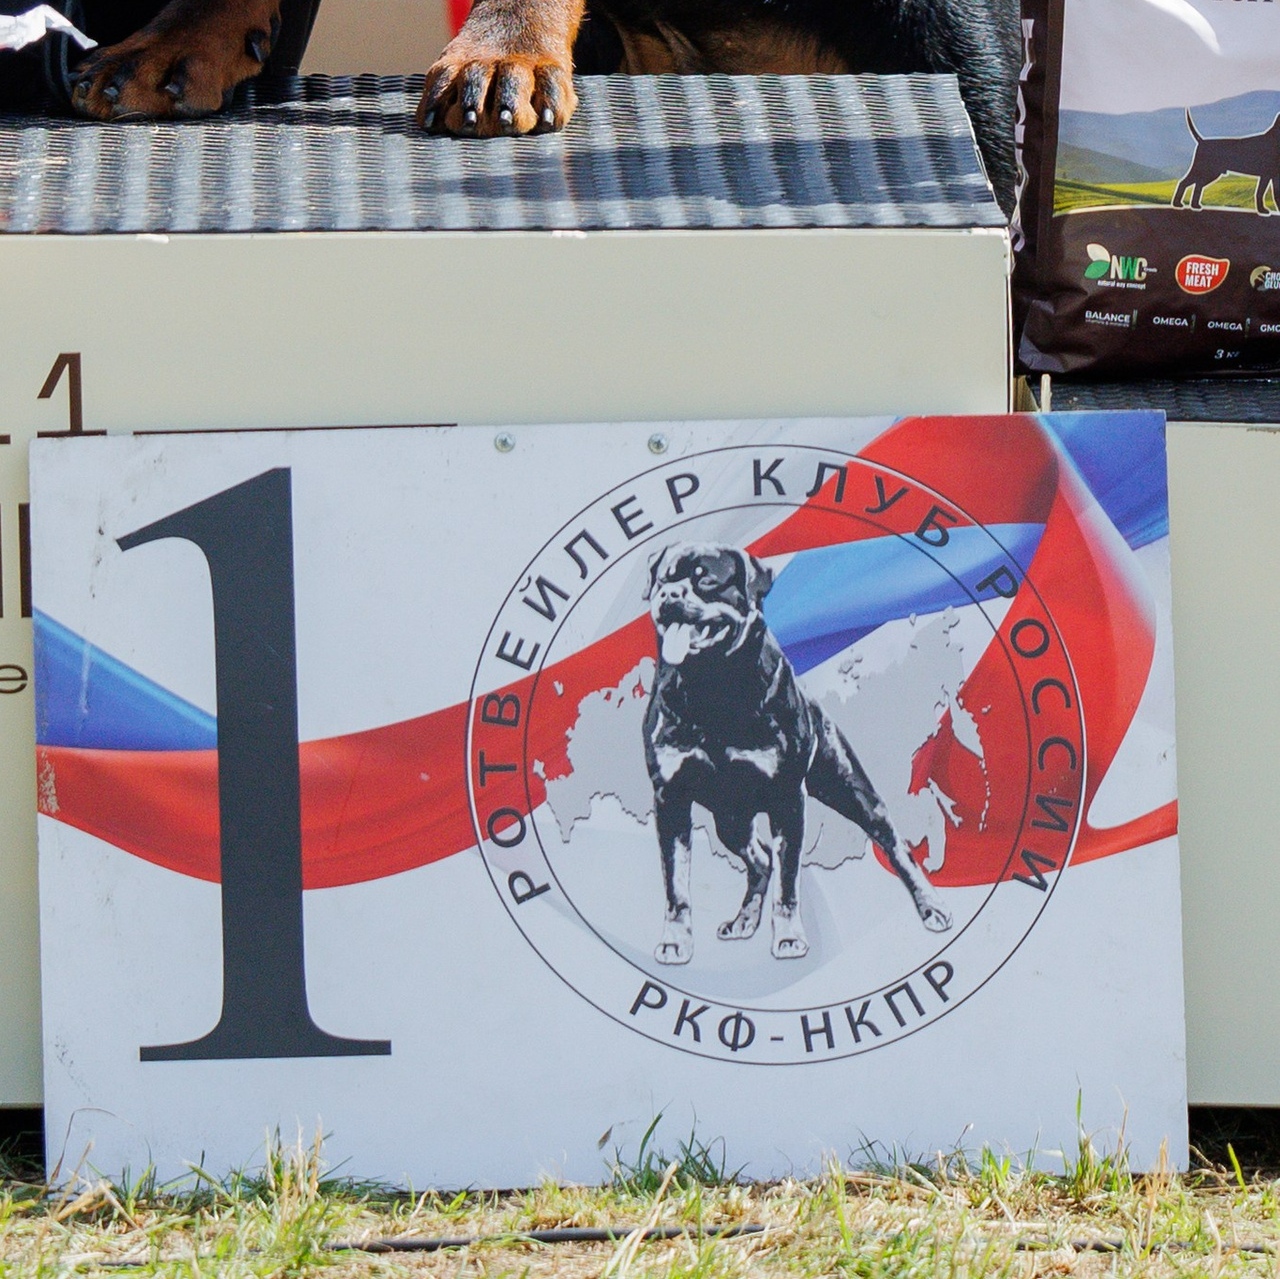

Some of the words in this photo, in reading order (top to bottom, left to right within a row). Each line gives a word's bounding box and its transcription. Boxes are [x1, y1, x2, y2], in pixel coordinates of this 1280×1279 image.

[1110, 255, 1148, 281] NWC
[1186, 262, 1220, 276] FRESH
[1184, 275, 1213, 288] MEAT
[1085, 310, 1131, 324] BALANCE
[1152, 316, 1189, 327] OMEGA
[1207, 321, 1243, 332] OMEGA
[479, 473, 701, 906] РОТВЕЙЛЕР
[752, 458, 959, 548] КЛУБ
[974, 565, 1077, 894] РОССИИ
[117, 466, 392, 1063] 1
[629, 959, 956, 1054] РКФ-НКПР
